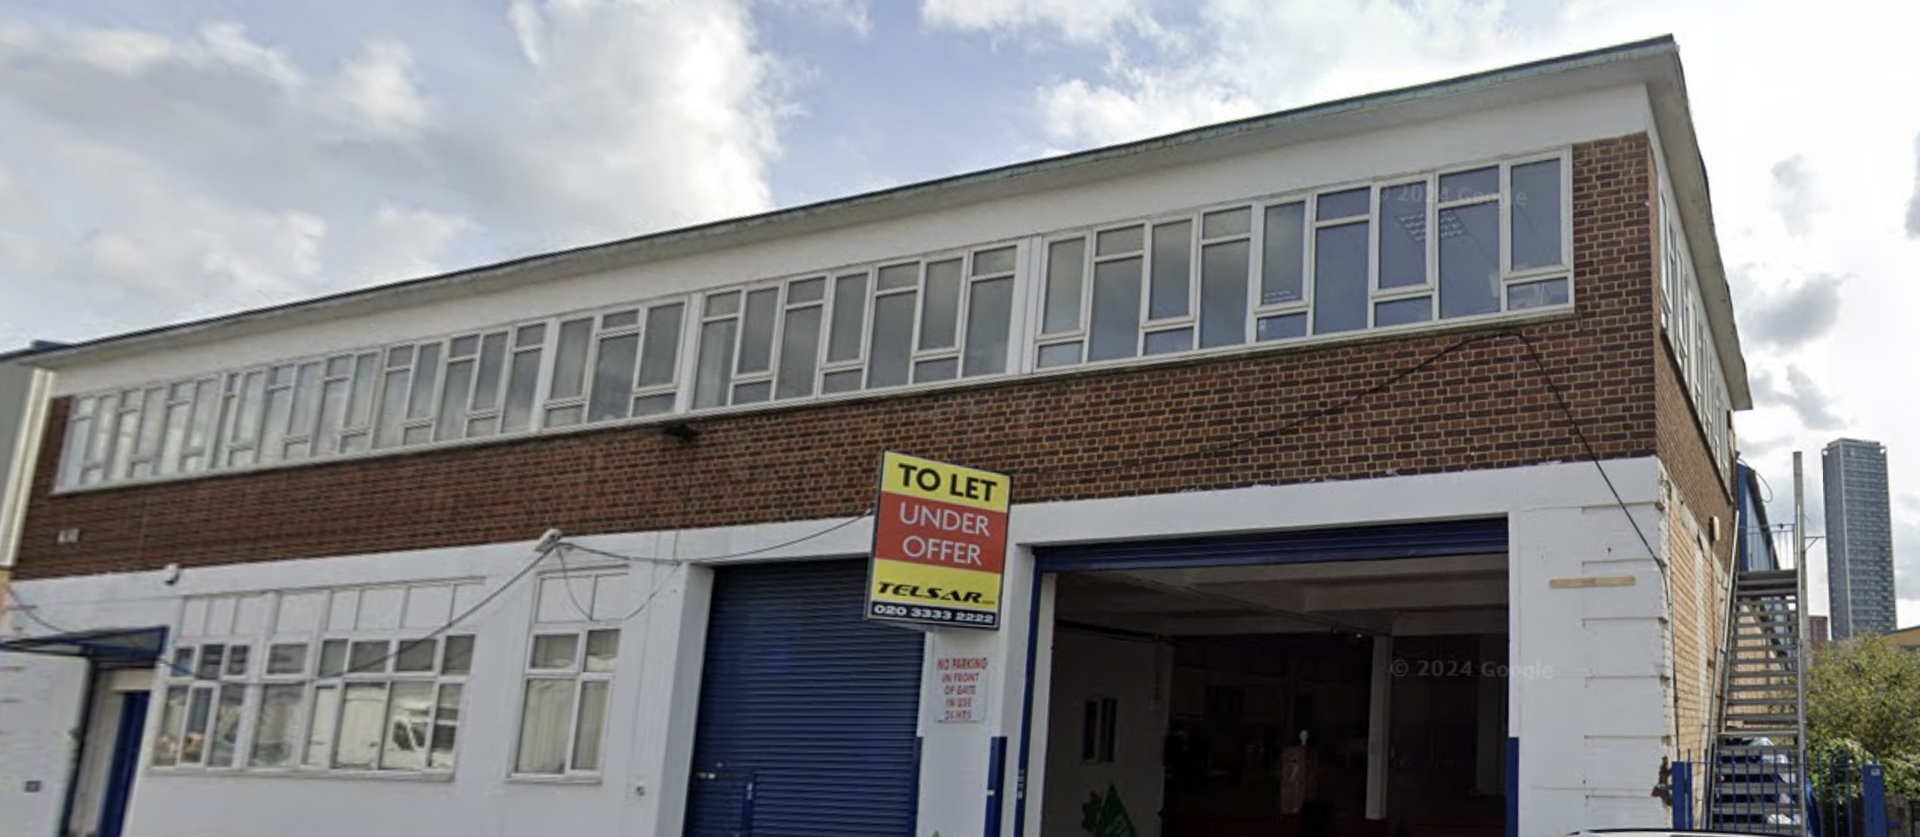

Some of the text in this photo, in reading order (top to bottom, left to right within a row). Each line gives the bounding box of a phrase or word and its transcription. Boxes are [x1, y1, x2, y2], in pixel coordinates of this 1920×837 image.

[898, 463, 998, 502] TO LET
[900, 501, 991, 537] UNDER
[903, 535, 982, 567] OFFER
[873, 604, 994, 624] 020 3333 2222
[936, 656, 988, 671] NO PARKING
[941, 672, 979, 683] IN FRONT
[944, 684, 976, 695] OF GATE
[957, 697, 972, 708] USE
